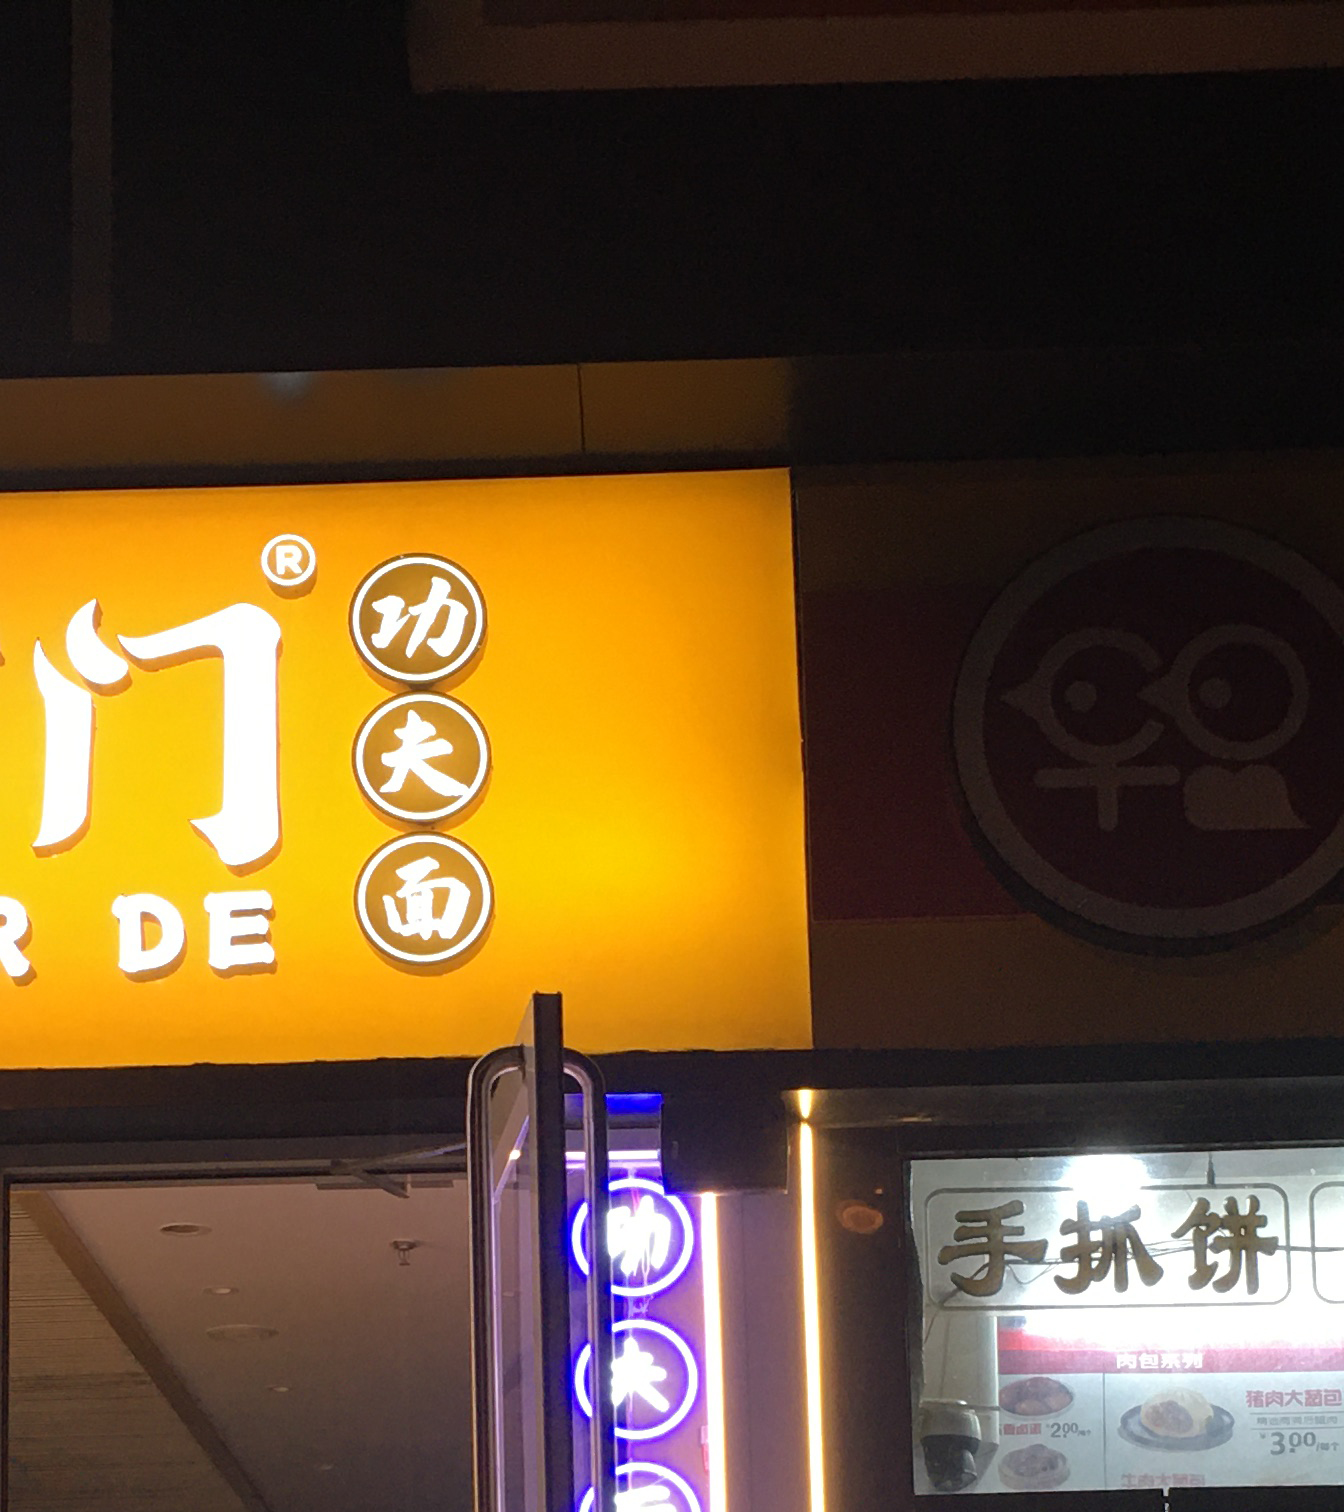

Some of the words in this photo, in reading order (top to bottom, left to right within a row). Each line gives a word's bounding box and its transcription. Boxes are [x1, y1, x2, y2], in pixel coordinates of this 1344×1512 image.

[364, 570, 480, 948] 功夫面
[111, 891, 278, 978] DE
[937, 1194, 1280, 1296] 手抓饼
[1116, 1353, 1203, 1369] 肉包系列
[1246, 1389, 1343, 1408] 猪肉大葱包
